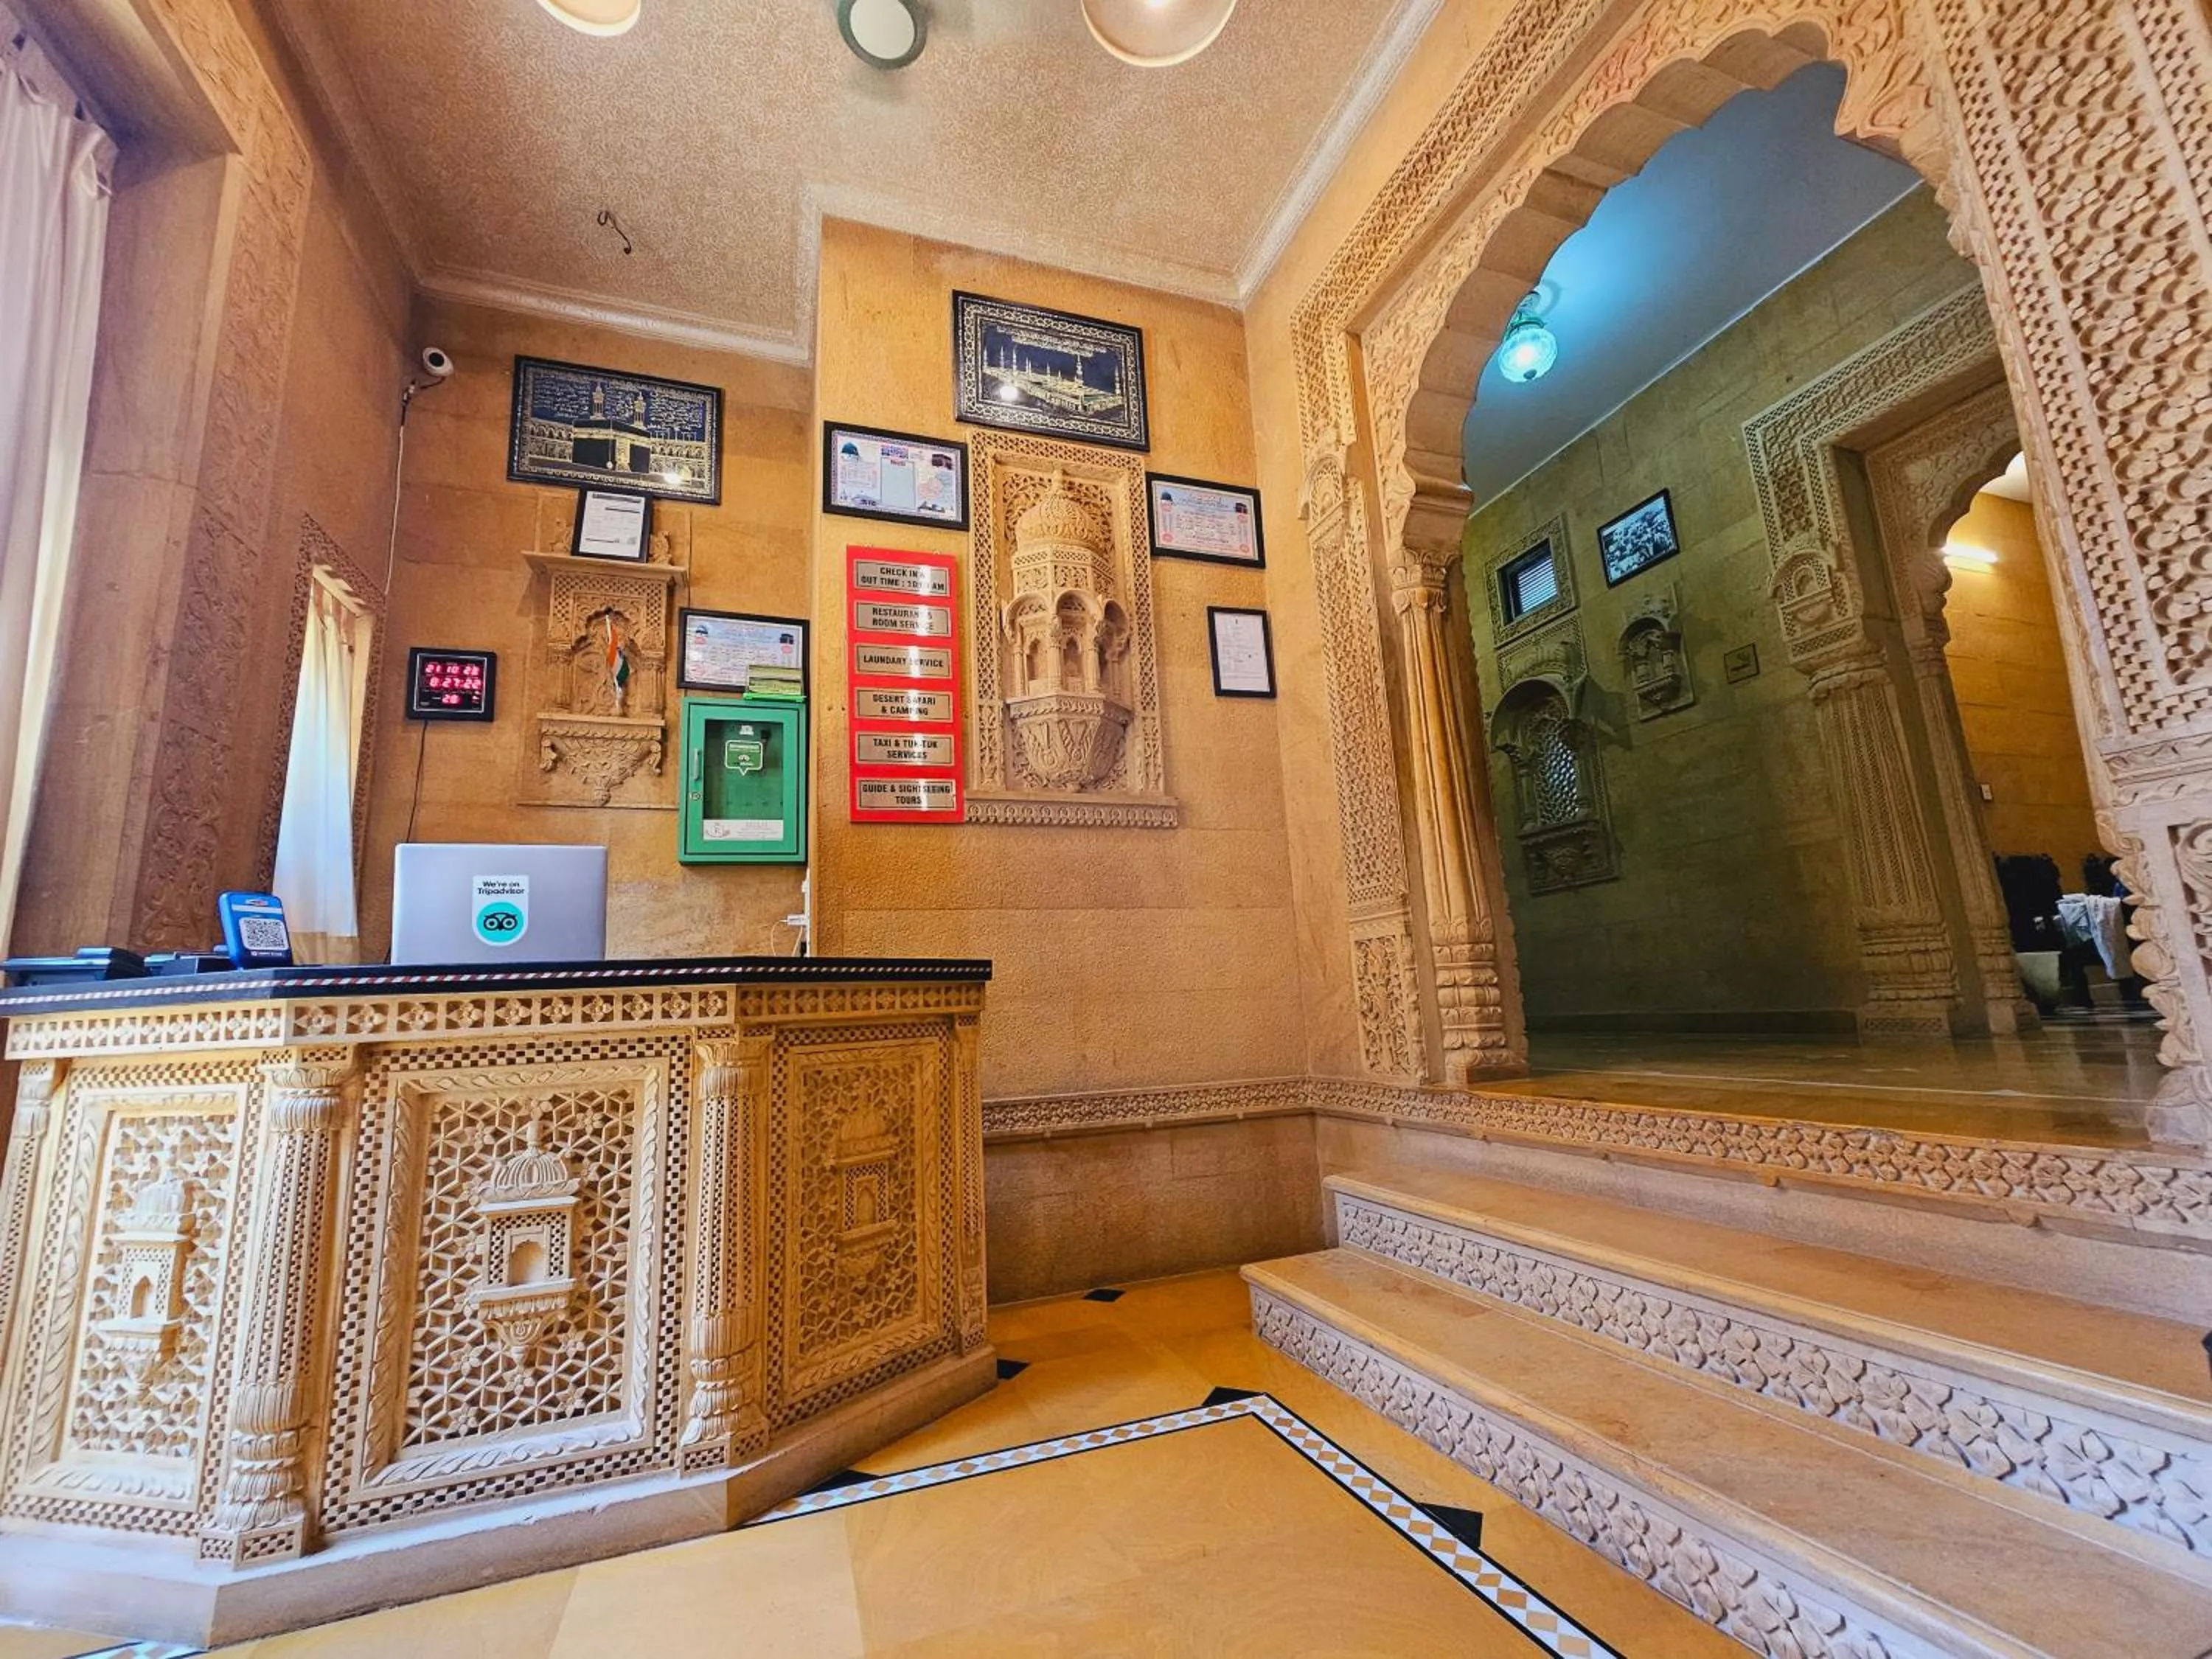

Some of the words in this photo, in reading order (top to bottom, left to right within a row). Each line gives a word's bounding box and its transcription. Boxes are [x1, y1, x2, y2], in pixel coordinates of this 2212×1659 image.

[880, 567, 908, 577] CHECK
[909, 570, 918, 578] IN
[860, 576, 877, 585] OUT
[880, 577, 899, 587] TIME
[932, 582, 945, 591] AM
[872, 607, 924, 619] RESTAURAN
[872, 618, 897, 627] ROOM
[900, 621, 933, 630] SERVE
[863, 654, 906, 665] LAUNDARY
[873, 694, 905, 703] DESERT
[873, 738, 891, 747] TAXI
[894, 739, 900, 747] &
[887, 750, 927, 759] SERVICES
[863, 784, 887, 793] GUIDE
[890, 784, 896, 793] &
[899, 784, 950, 794] SIGHTSEEING
[895, 796, 921, 804] TOURS
[477, 887, 525, 896] Tripadvisor
